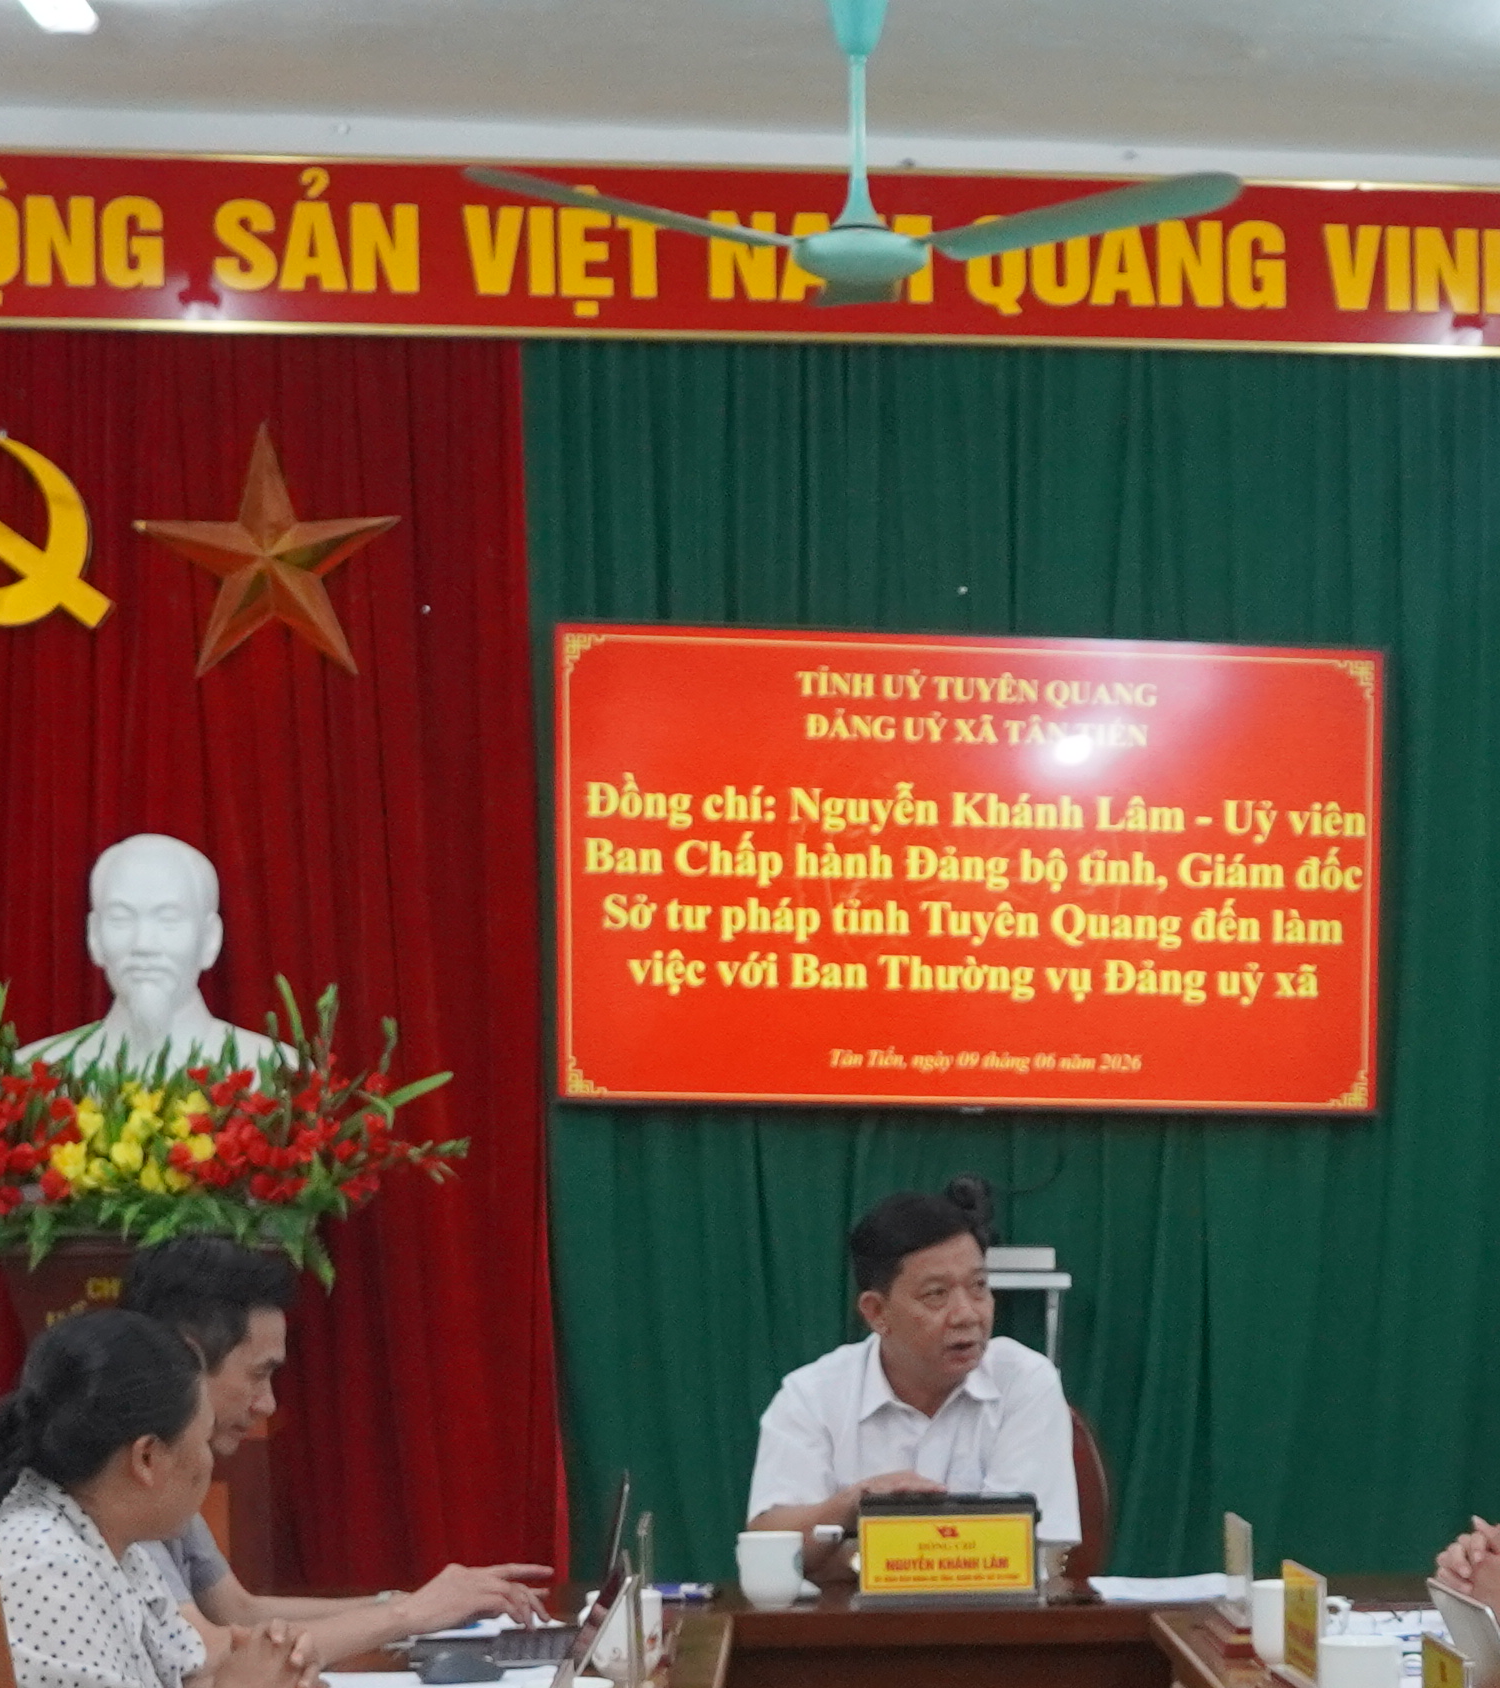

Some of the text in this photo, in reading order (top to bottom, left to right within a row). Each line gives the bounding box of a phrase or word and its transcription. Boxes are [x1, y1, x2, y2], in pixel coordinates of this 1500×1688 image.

[213, 167, 420, 293] SẢN
[463, 185, 661, 317] VIỆT
[965, 214, 1287, 316] QUANG
[795, 665, 1158, 709] TỈNH UỶ TUYÊN QUANG
[805, 708, 896, 741] ĐẢNG
[903, 711, 949, 744] UỶ
[953, 714, 999, 744] XÃ
[586, 772, 694, 830] Đồng
[702, 785, 776, 823] chí:
[789, 781, 939, 834] Nguyễn
[951, 792, 1084, 831] Khánh
[1095, 795, 1185, 832] Lâm
[1223, 799, 1278, 844] Uỷ
[1287, 801, 1367, 837] viên
[585, 830, 1363, 893] Ban Chấp hành Đảng bộ tỉnh, Giám đốc
[603, 893, 1343, 950] Sở tư pháp tỉnh Tuyên Quang đến làm
[627, 949, 1319, 1007] việc với Ban Thường vụ Đảng uỷ xã
[911, 1050, 951, 1074] ngày
[982, 1051, 1031, 1075] tháng
[1058, 1054, 1097, 1071] năm
[1099, 1053, 1143, 1072] 2026
